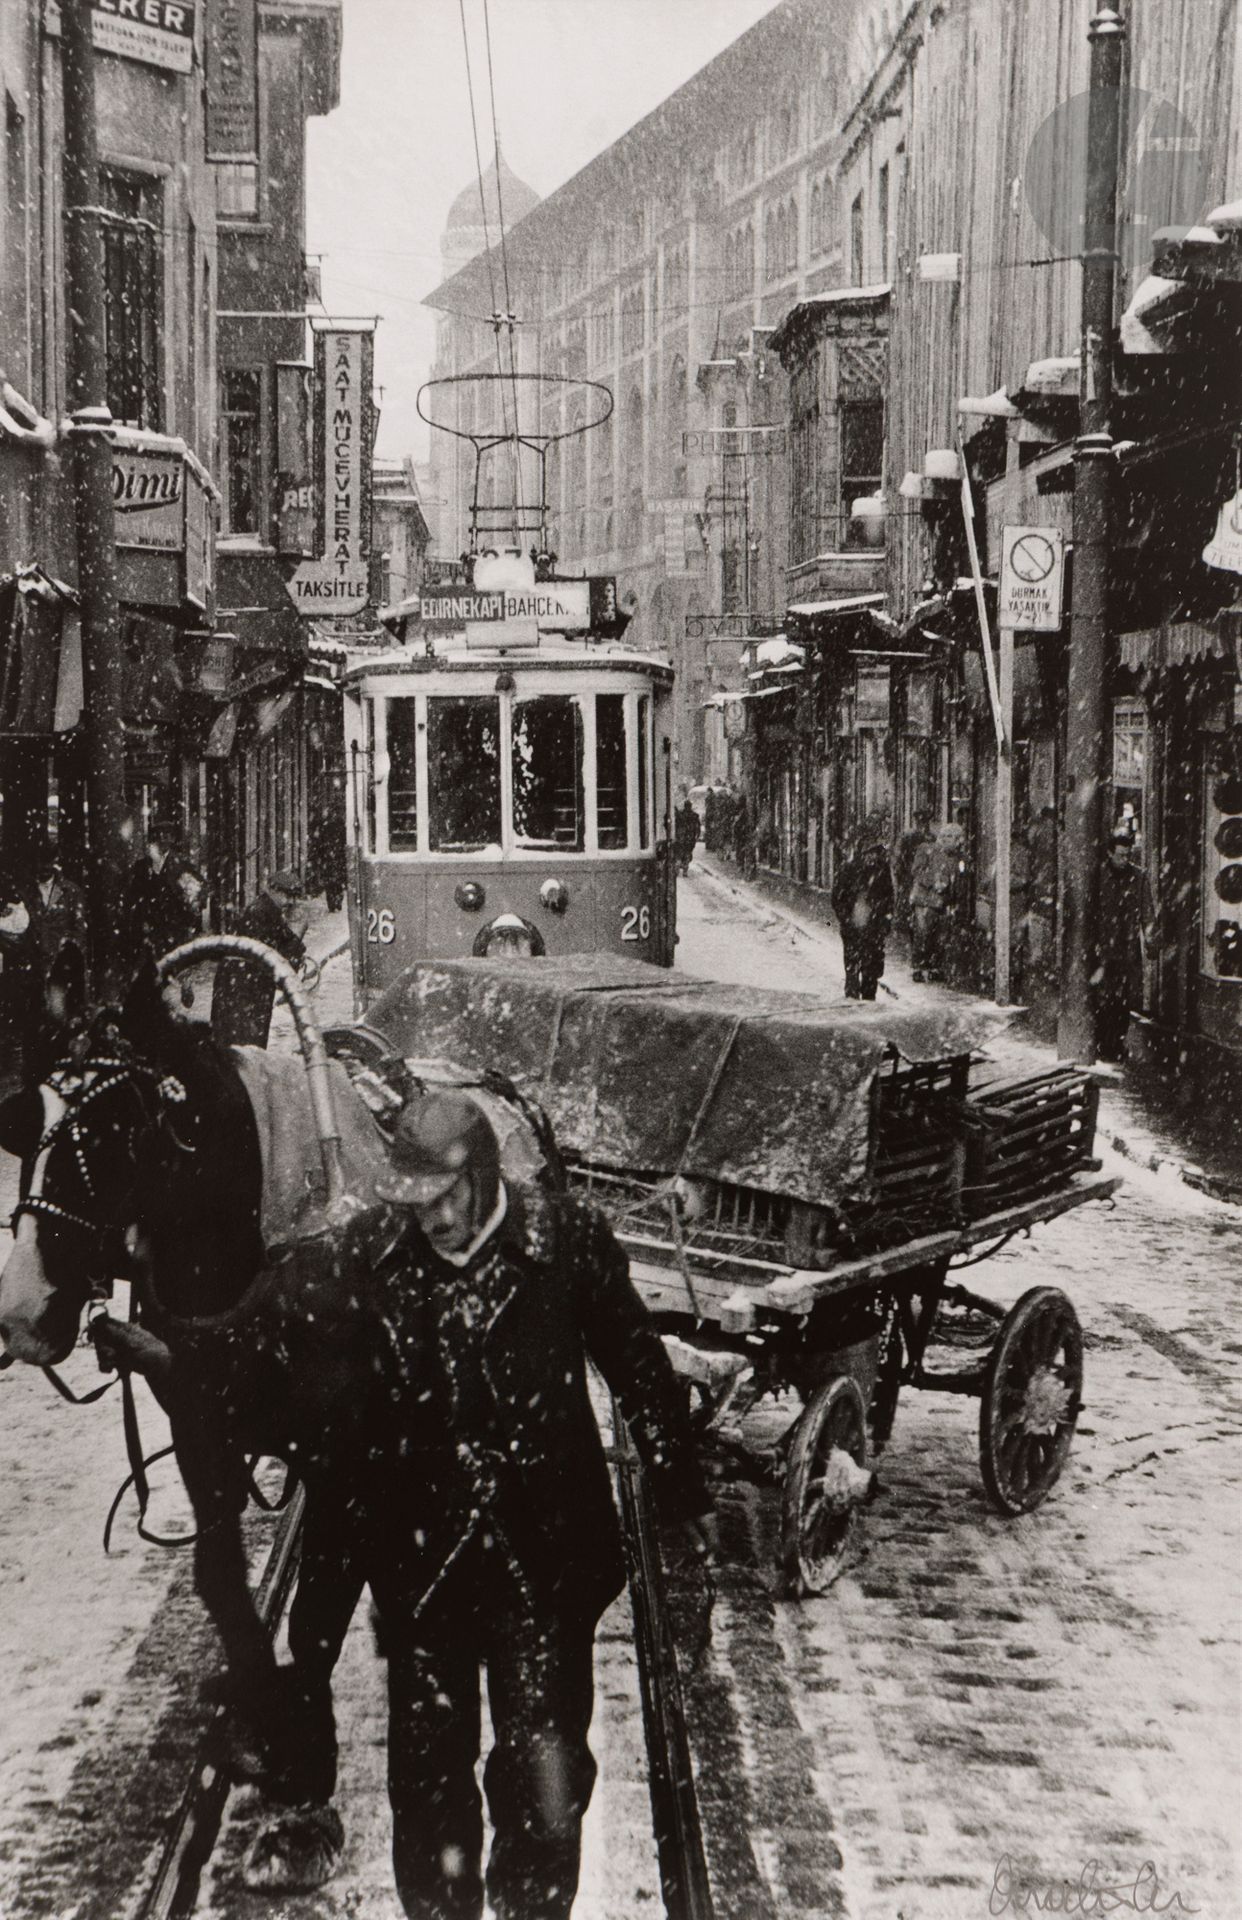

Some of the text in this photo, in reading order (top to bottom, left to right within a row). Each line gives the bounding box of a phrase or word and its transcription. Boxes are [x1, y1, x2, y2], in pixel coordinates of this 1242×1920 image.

[336, 336, 351, 401] SAAT
[367, 908, 395, 944] 26
[620, 905, 650, 941] 26
